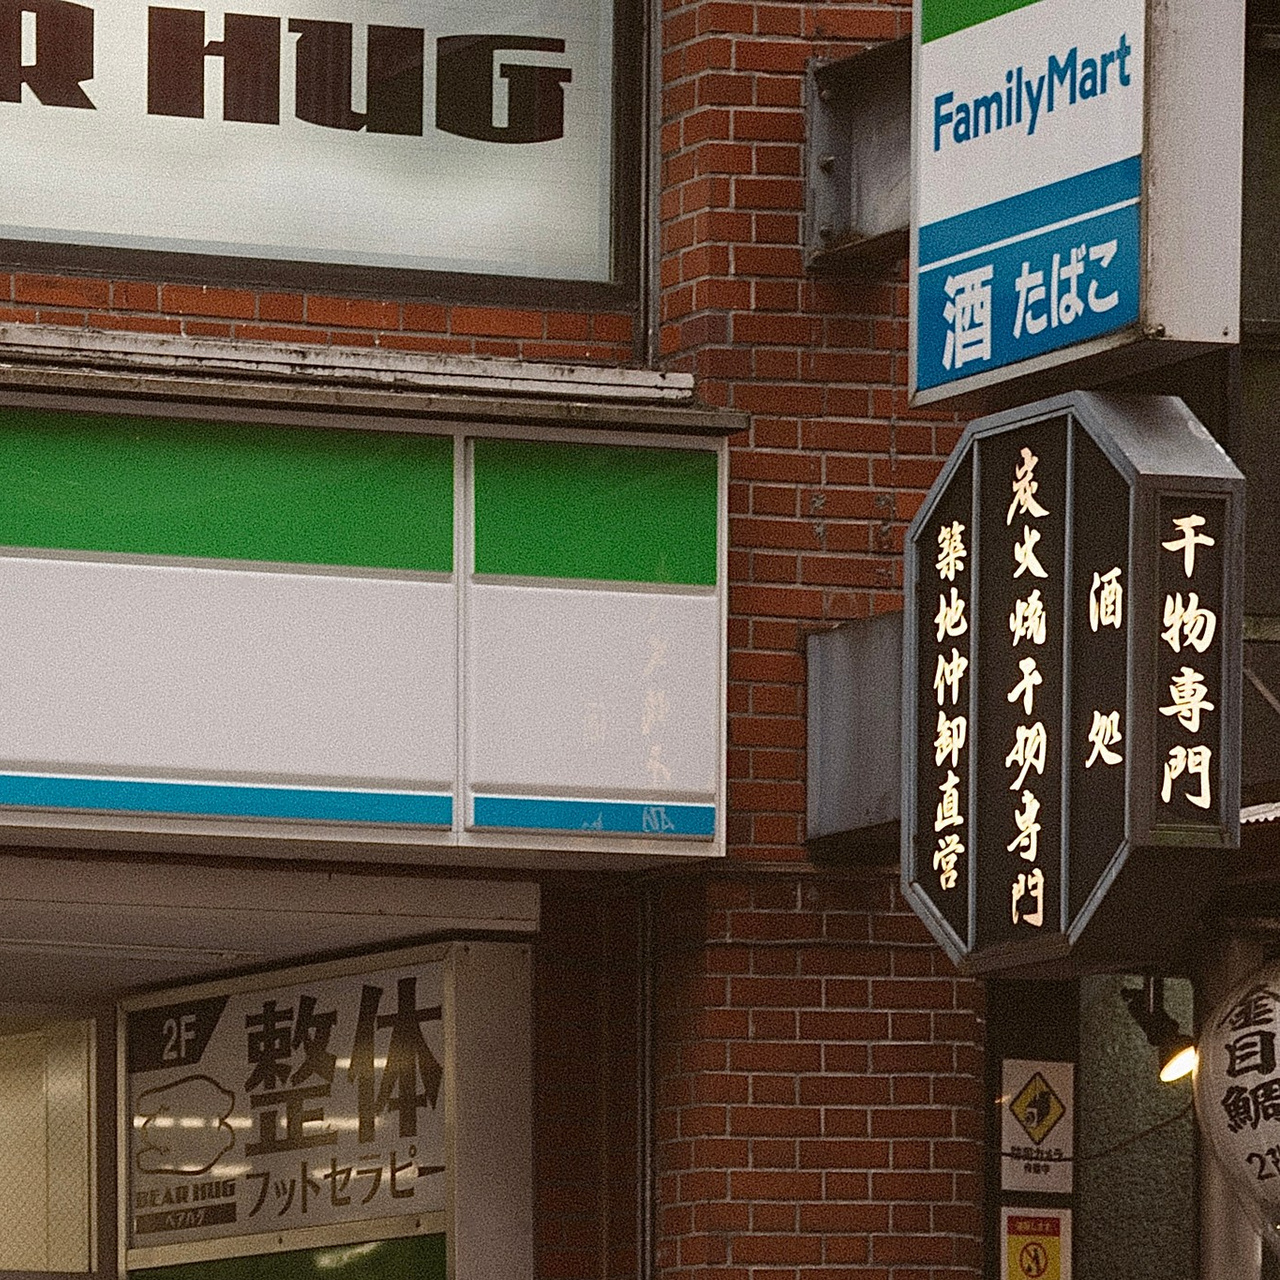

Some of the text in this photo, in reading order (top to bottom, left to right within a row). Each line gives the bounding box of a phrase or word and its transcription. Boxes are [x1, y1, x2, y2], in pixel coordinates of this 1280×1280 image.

[147, 9, 572, 144] HUG
[933, 34, 1132, 151] FamilyMart
[942, 239, 1119, 370] 酒 たばこ
[1159, 514, 1217, 810] 干物専門
[162, 1014, 197, 1061] 2F
[243, 976, 445, 1158] 整体
[245, 1144, 446, 1218] フットセラピー
